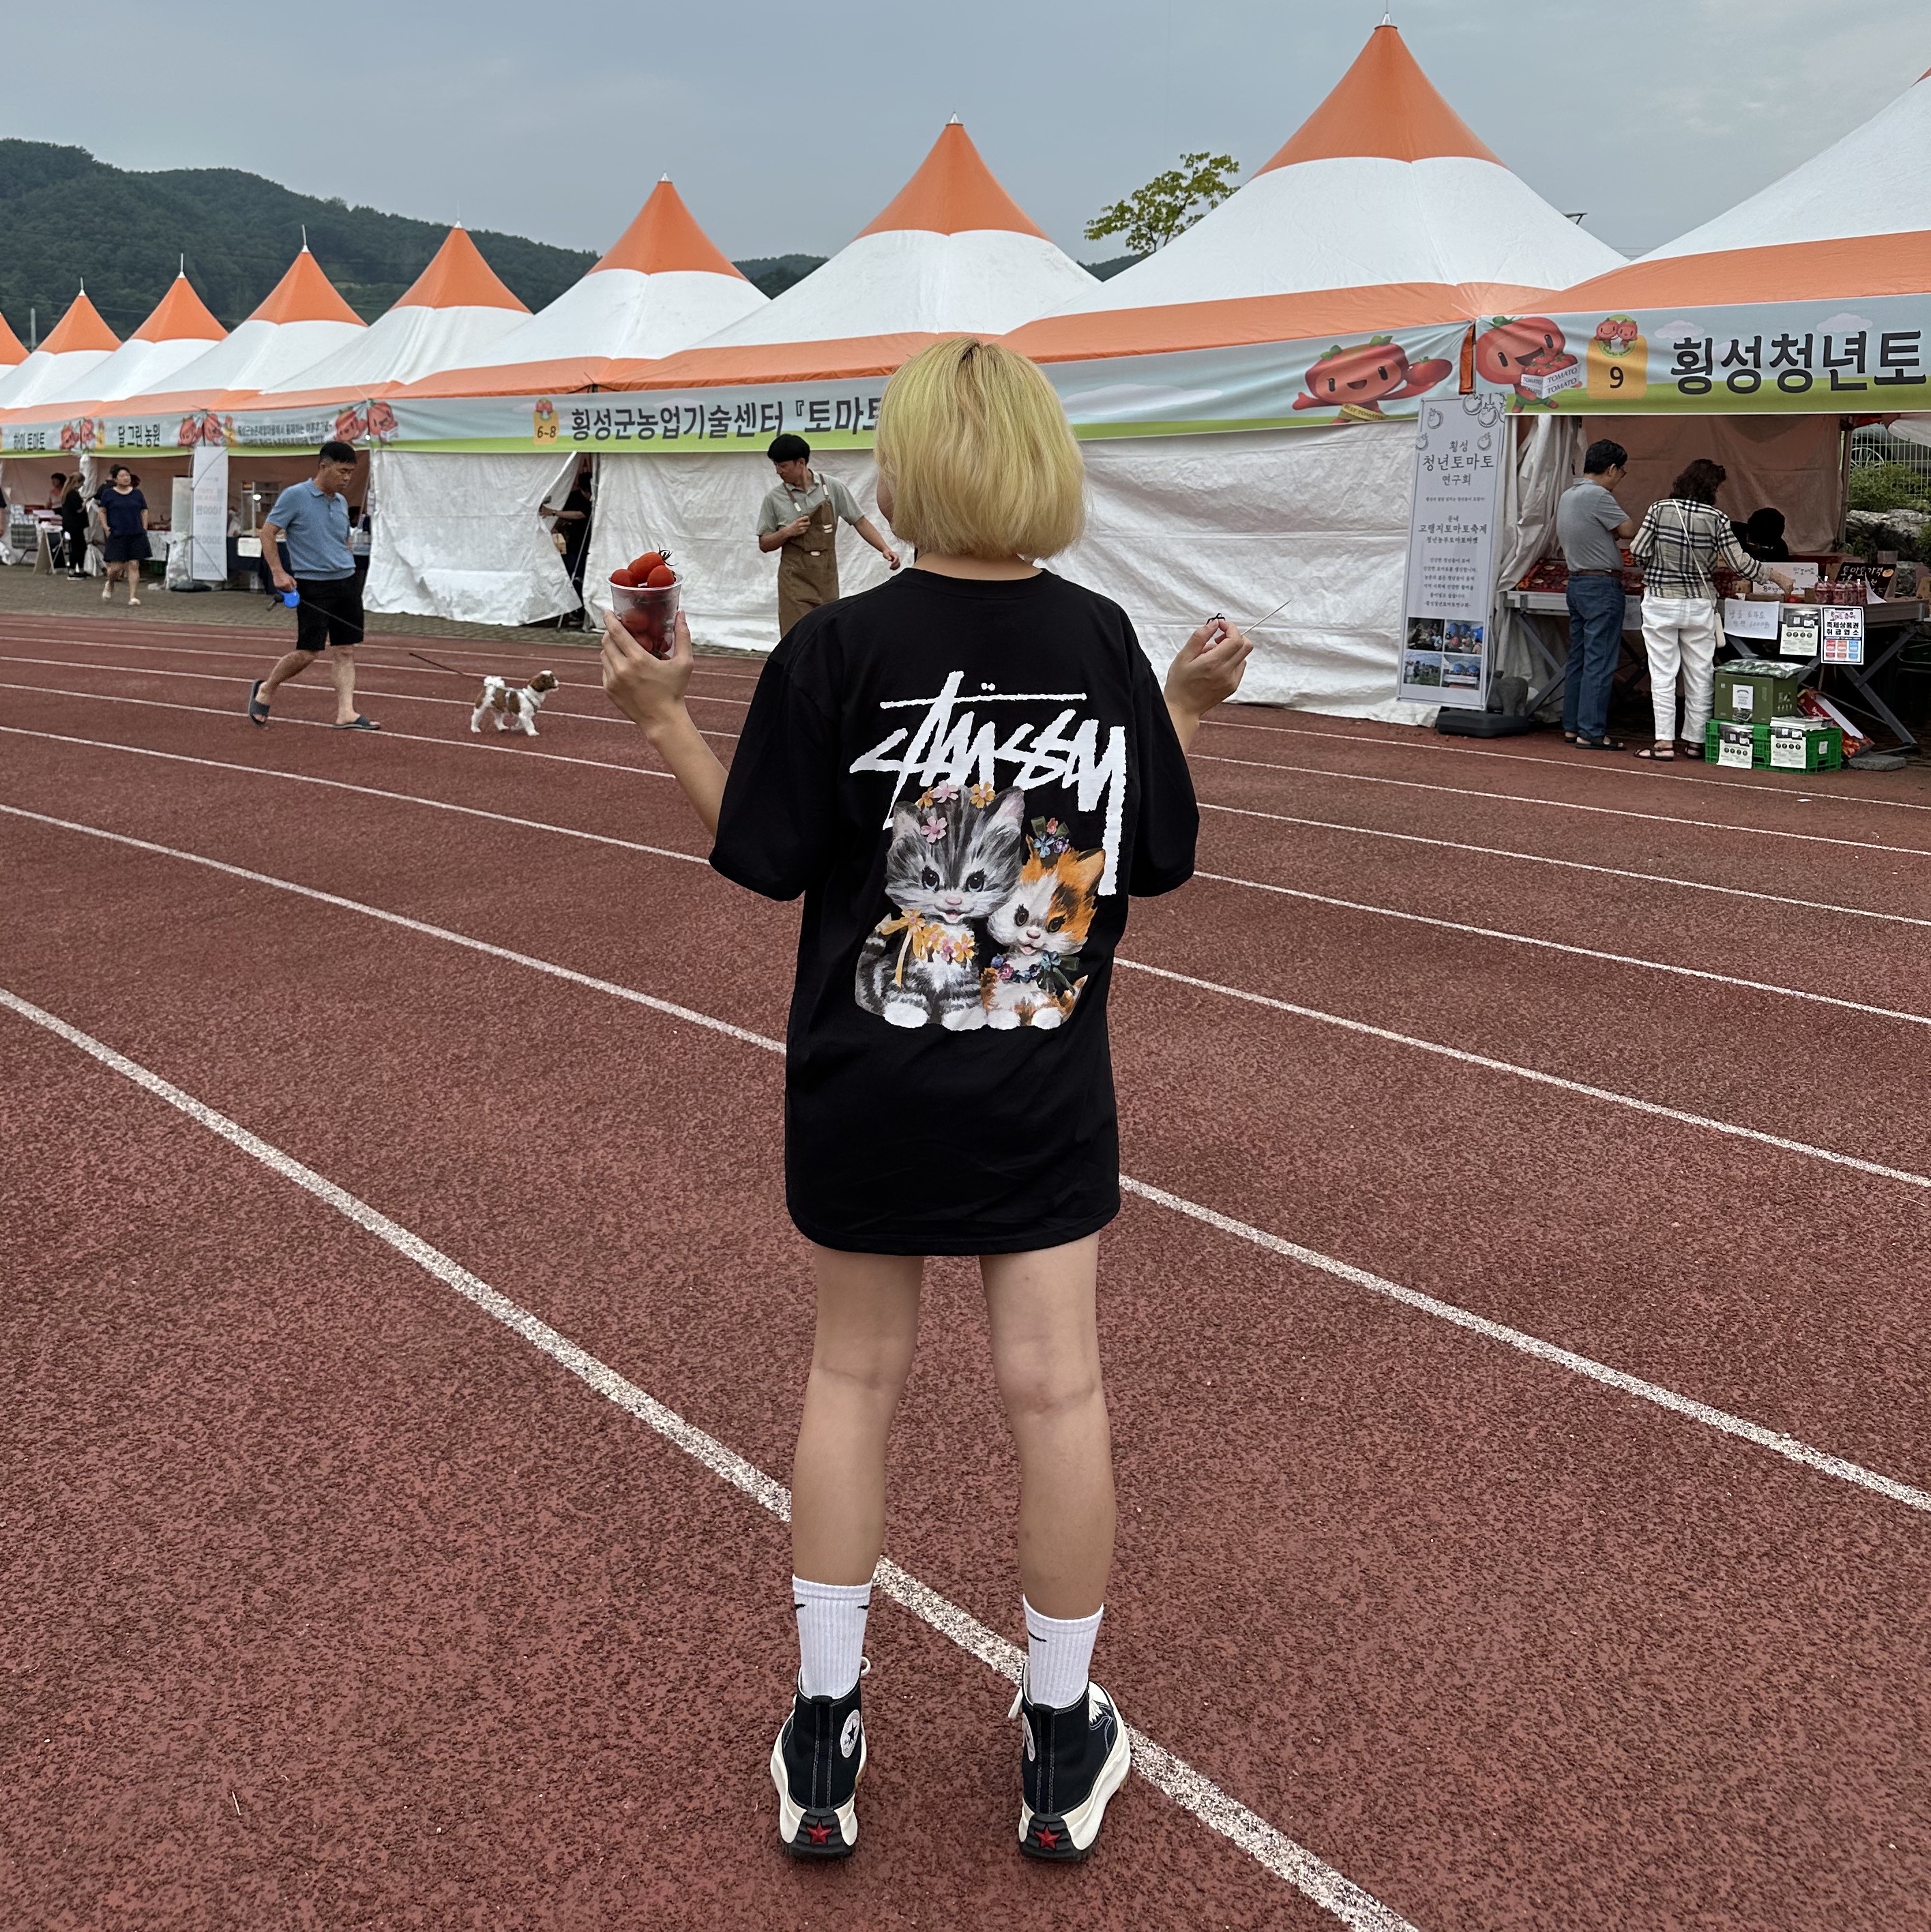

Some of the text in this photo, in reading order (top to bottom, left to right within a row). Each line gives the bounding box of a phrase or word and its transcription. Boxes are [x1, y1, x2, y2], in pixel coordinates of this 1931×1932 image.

[1670, 330, 1927, 395] 횡성청년토
[1547, 367, 1578, 383] TOMATO
[1610, 366, 1624, 389] 9
[1546, 377, 1577, 394] TOMATO
[572, 401, 782, 441] 횡성군농업기술센터
[1449, 440, 1469, 452] 횡성
[1422, 454, 1494, 471] 청년토마토
[1442, 473, 1471, 486] 연구회
